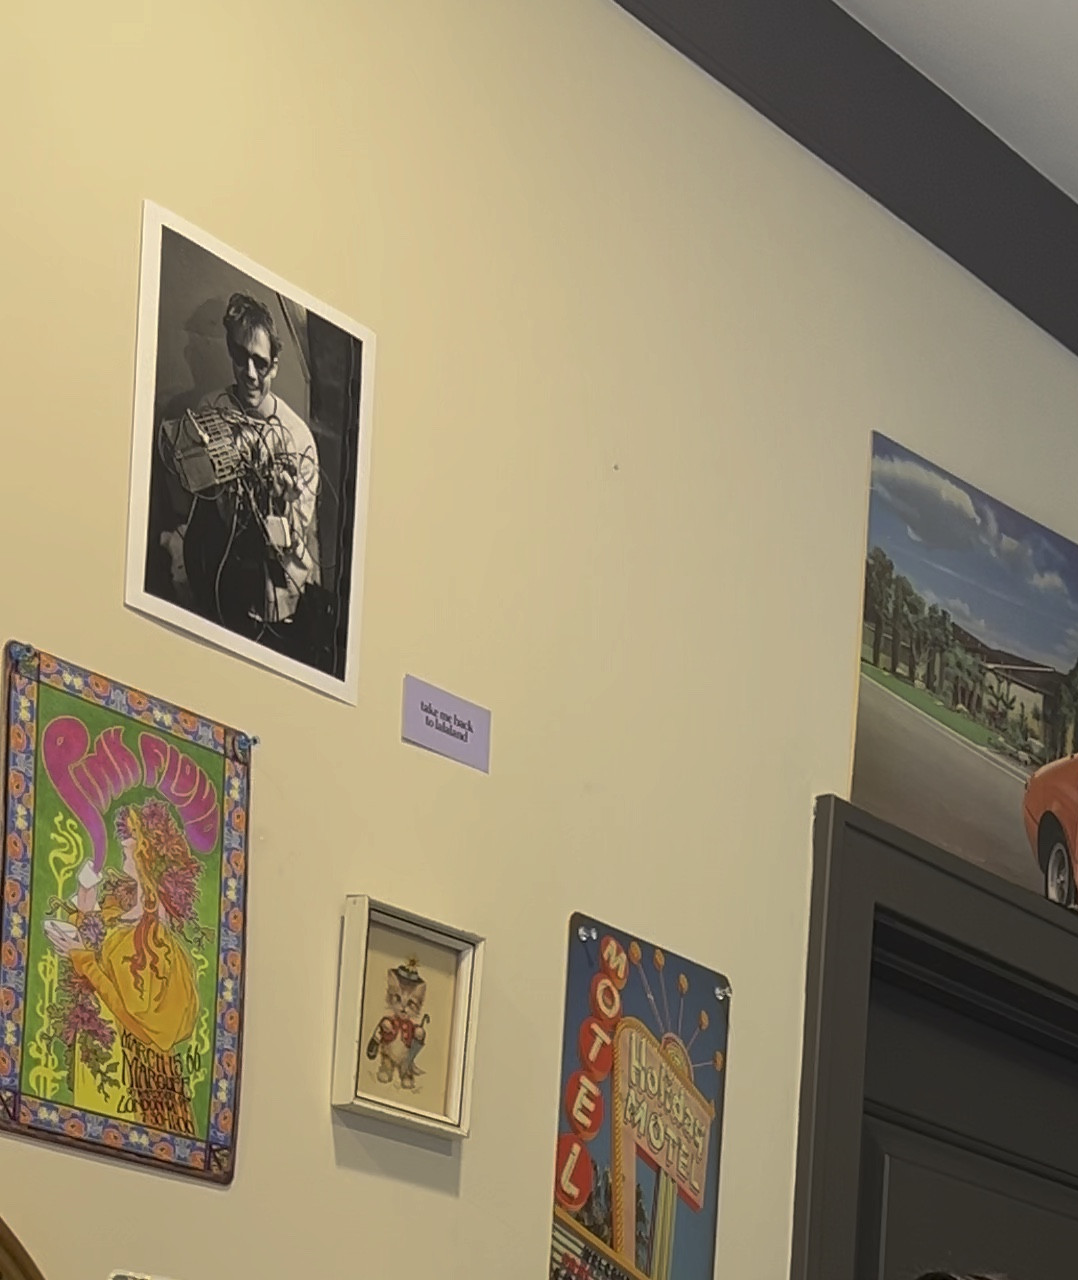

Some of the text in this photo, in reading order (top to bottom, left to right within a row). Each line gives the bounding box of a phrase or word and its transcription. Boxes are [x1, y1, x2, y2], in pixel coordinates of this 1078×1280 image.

[425, 715, 434, 728] to
[42, 715, 221, 875] PINK FLOYD
[560, 939, 628, 1199] MOTEL
[624, 1089, 701, 1196] MOTEL
